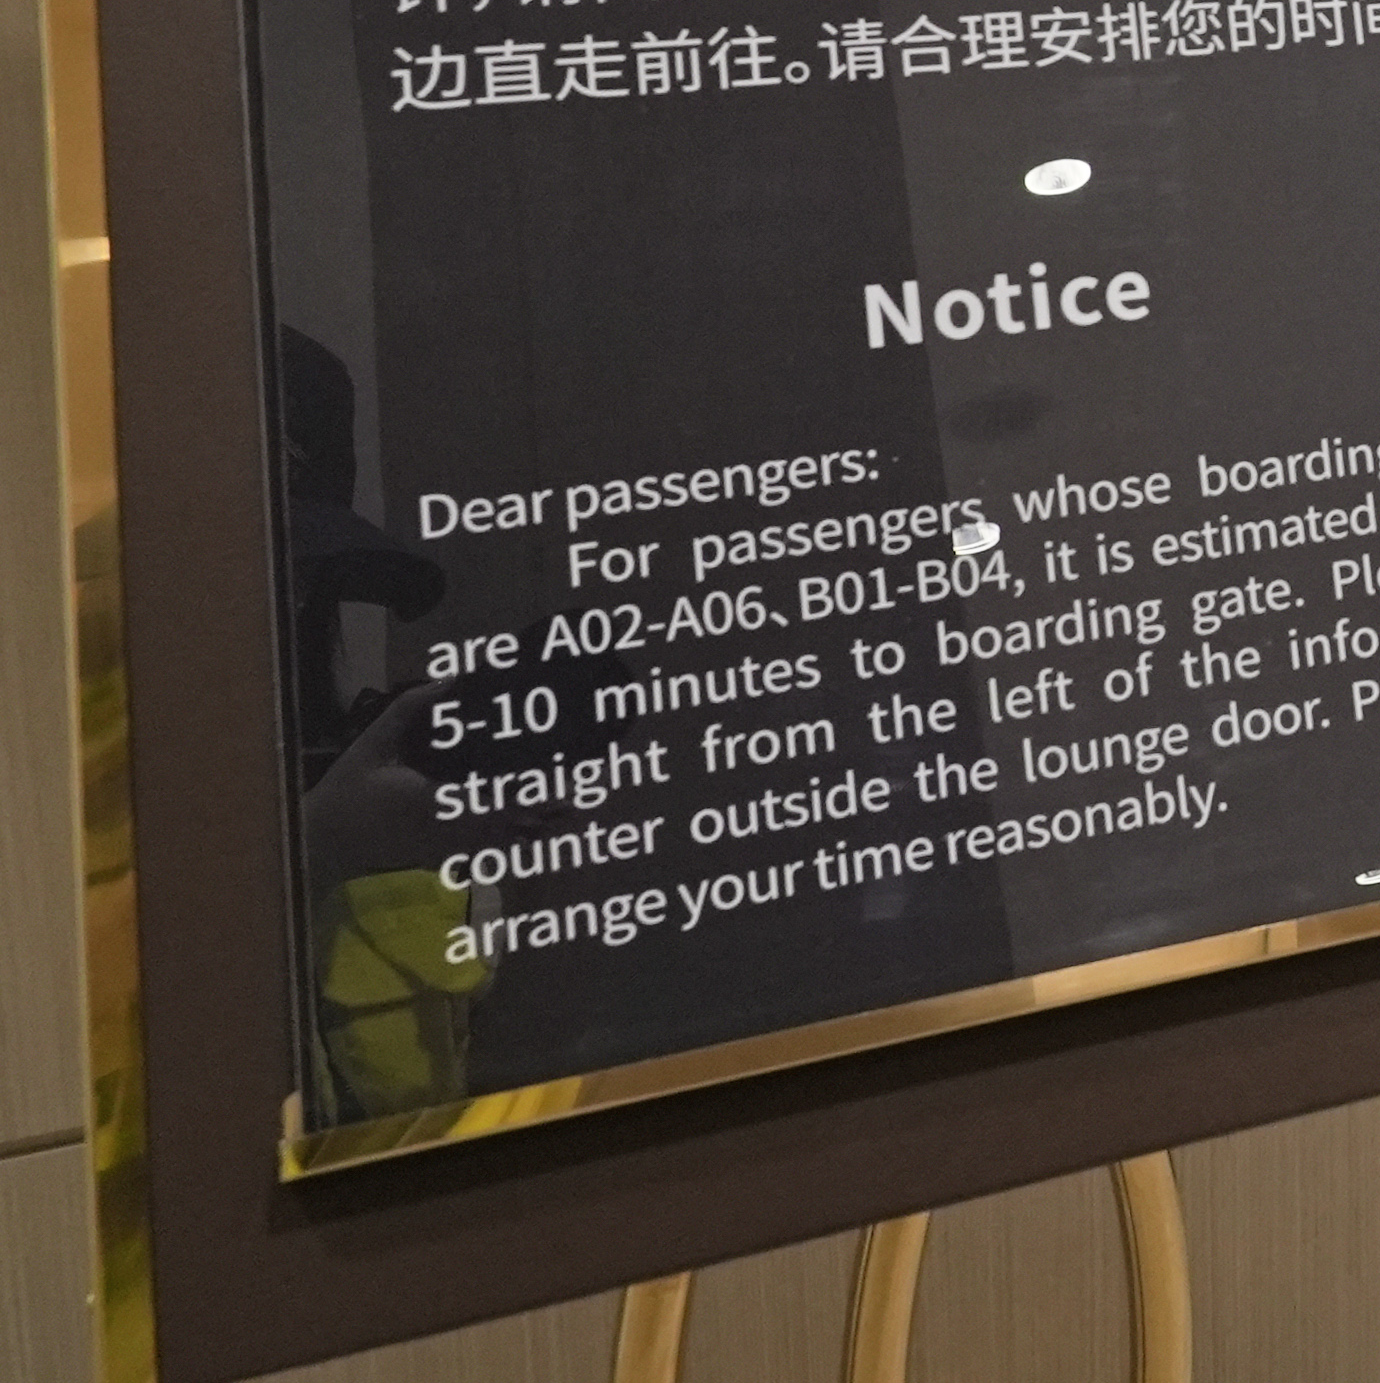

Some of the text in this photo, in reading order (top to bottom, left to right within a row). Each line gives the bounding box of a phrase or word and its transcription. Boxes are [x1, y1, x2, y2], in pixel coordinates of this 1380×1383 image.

[864, 262, 1150, 349] Notice
[419, 449, 879, 540] Dear passengers:
[569, 541, 660, 588] For
[1013, 473, 1171, 523] whose
[427, 633, 519, 679] are
[1044, 541, 1079, 583] it
[1096, 533, 1134, 575] is
[1152, 492, 1377, 566] estimated
[431, 686, 558, 749] 5-10
[595, 654, 821, 722] minutes
[850, 639, 905, 679] to
[937, 598, 1166, 665] boarding
[1192, 577, 1304, 636] gate.
[435, 740, 670, 820] straight
[701, 720, 835, 773] from
[867, 693, 956, 743] the
[988, 668, 1075, 723] left
[1104, 651, 1153, 702] of
[1180, 642, 1261, 688] the
[439, 817, 664, 891] counter
[690, 769, 891, 844] outside
[913, 753, 998, 802] the
[1023, 723, 1189, 783] lounge
[1212, 698, 1330, 747] door.
[445, 774, 1227, 964] arrange your time reasonably.
